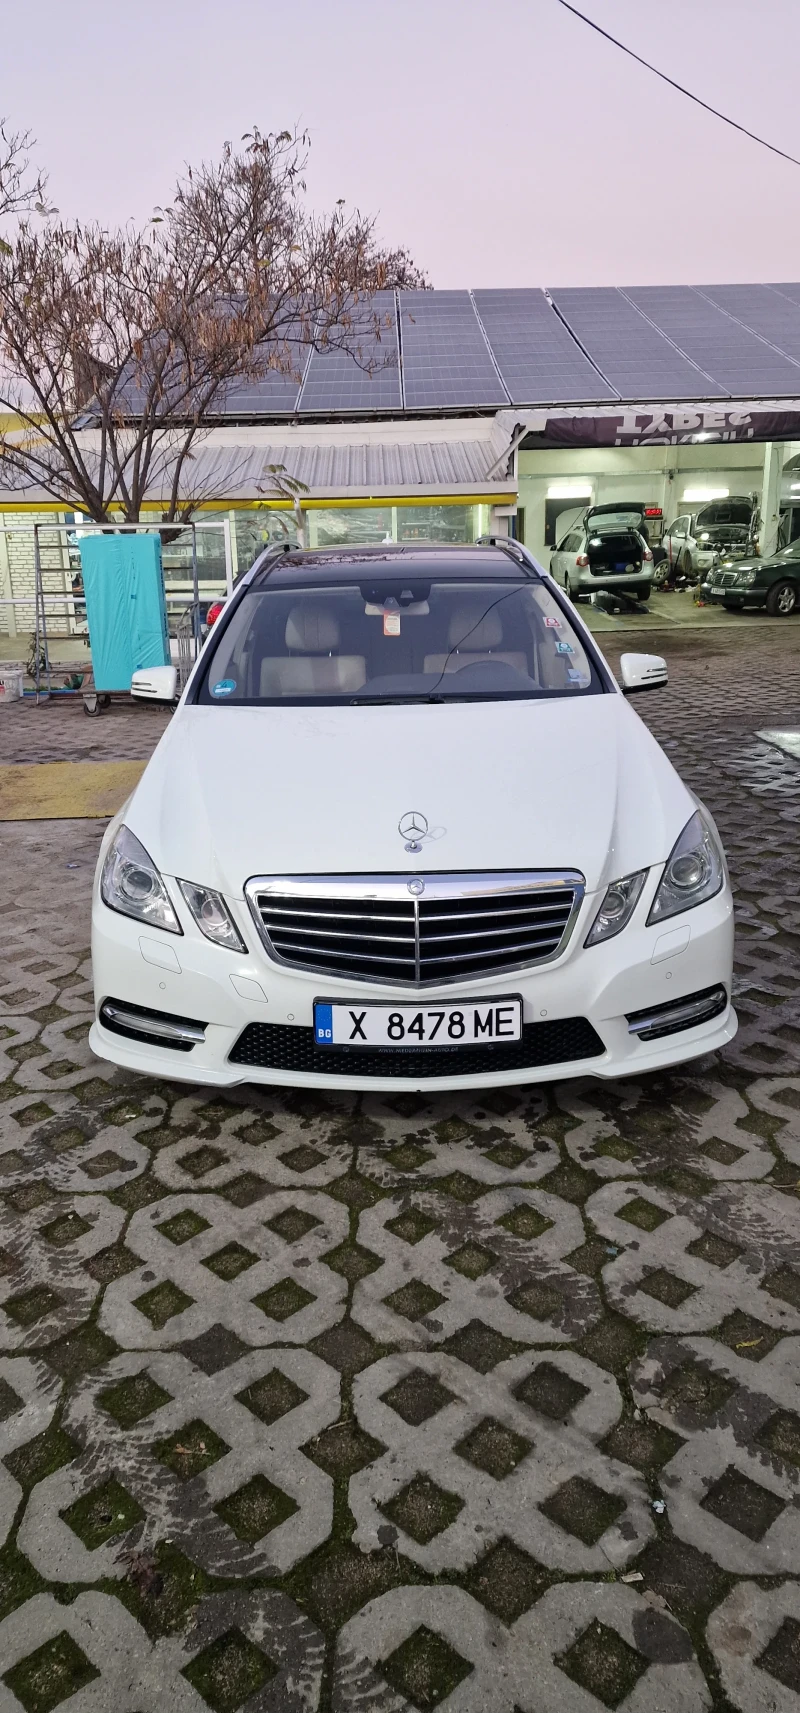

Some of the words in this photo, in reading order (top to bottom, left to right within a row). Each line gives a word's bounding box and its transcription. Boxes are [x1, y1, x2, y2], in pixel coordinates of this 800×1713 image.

[318, 1028, 332, 1038] BG
[348, 1011, 367, 1040] X
[387, 1011, 465, 1041] 8478
[473, 1006, 515, 1038] ME
